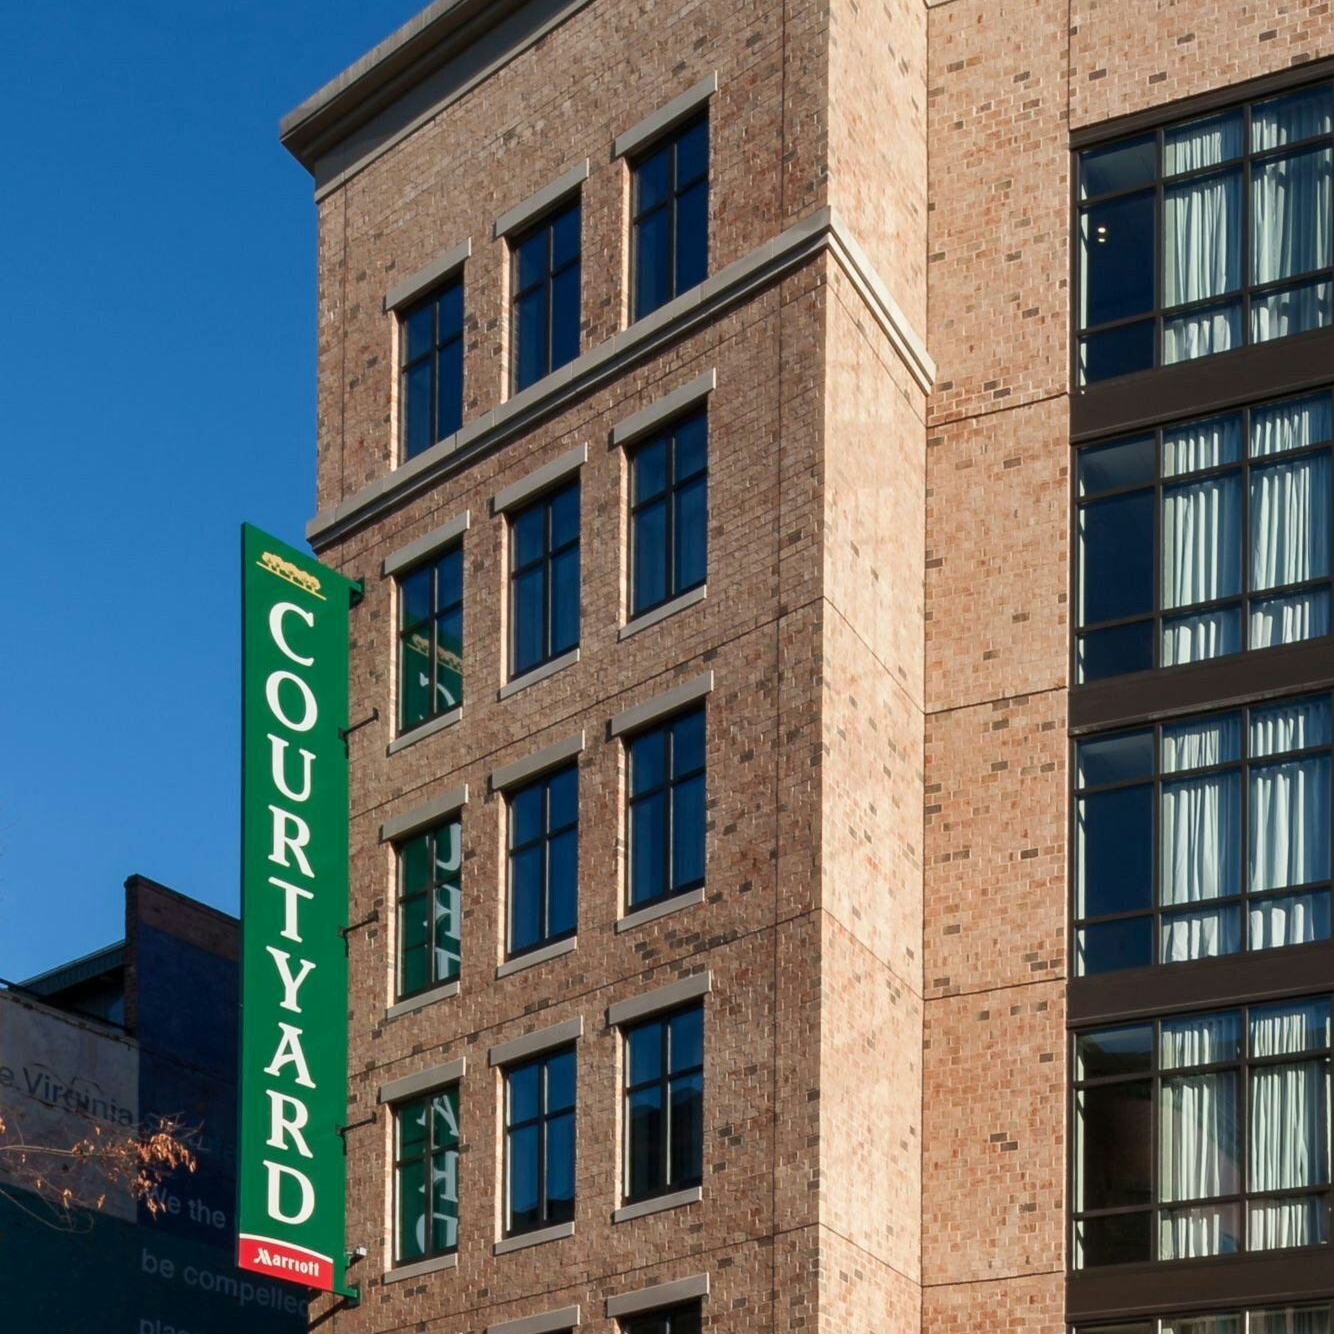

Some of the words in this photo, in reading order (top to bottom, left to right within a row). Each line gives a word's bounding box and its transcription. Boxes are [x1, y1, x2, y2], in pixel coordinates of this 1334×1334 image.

[264, 602, 319, 1225] COURTYARD
[23, 1067, 133, 1127] Virginia
[187, 1197, 226, 1229] the
[141, 1247, 175, 1279] be
[253, 1247, 319, 1277] Marriott
